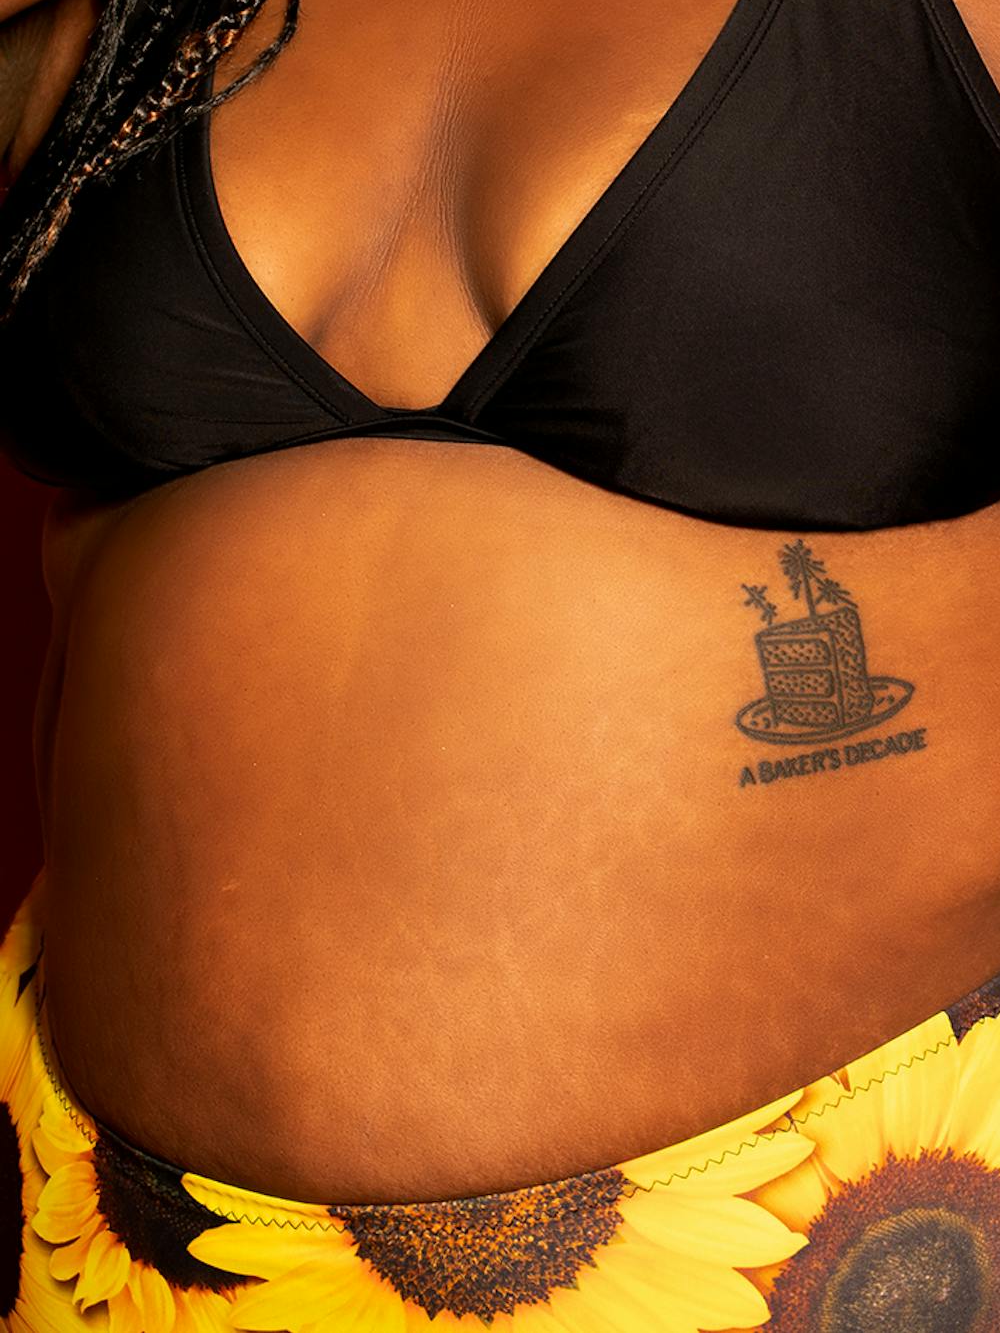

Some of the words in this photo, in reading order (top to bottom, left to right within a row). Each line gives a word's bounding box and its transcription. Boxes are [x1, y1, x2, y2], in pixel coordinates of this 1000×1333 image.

[739, 766, 757, 788] A
[758, 748, 841, 784] BAKER'S
[843, 728, 928, 766] DECADE
